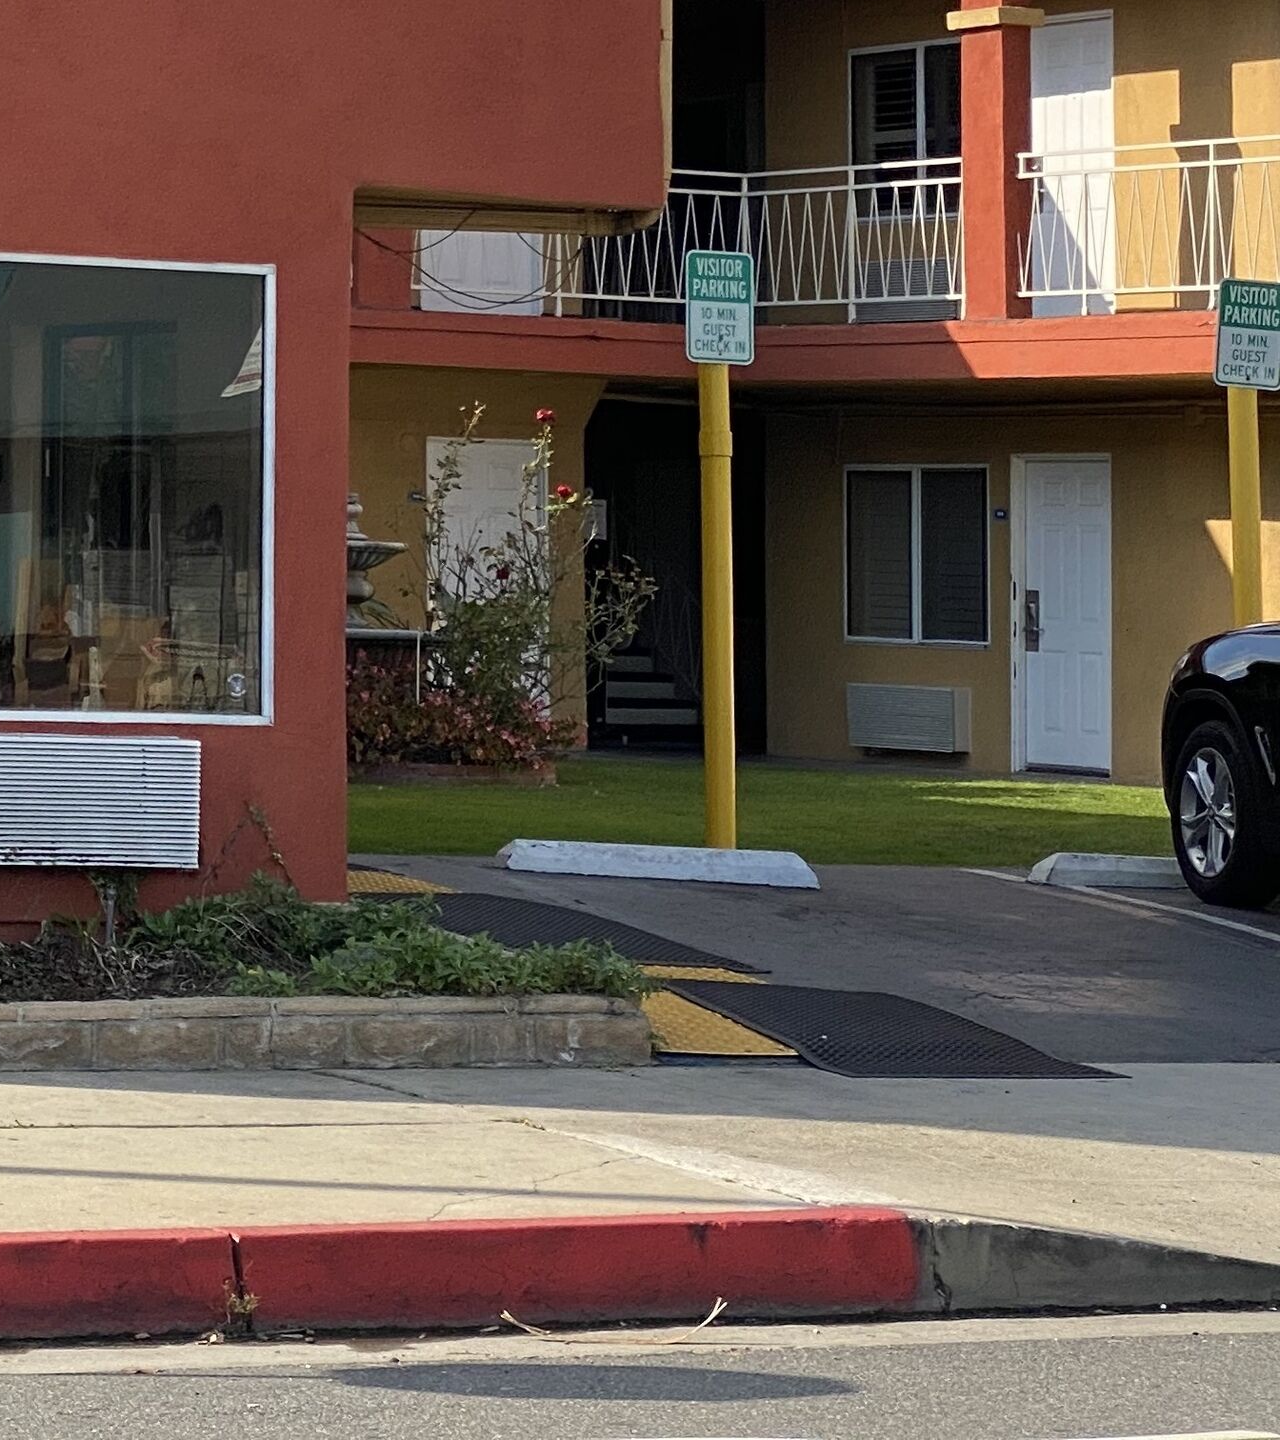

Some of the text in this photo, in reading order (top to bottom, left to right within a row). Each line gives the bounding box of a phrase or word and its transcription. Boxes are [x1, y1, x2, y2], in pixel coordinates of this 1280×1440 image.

[696, 257, 743, 278] VISITOR
[693, 278, 747, 299] PARKING
[1229, 285, 1278, 306] VISITOR
[701, 307, 712, 320] 10
[1224, 305, 1280, 327] PARKING
[703, 323, 736, 337] GUEST
[695, 339, 746, 354] CHECK IN
[1231, 333, 1242, 345] 10
[1232, 349, 1267, 363] GUEST
[1222, 363, 1275, 380] CHECK IN
